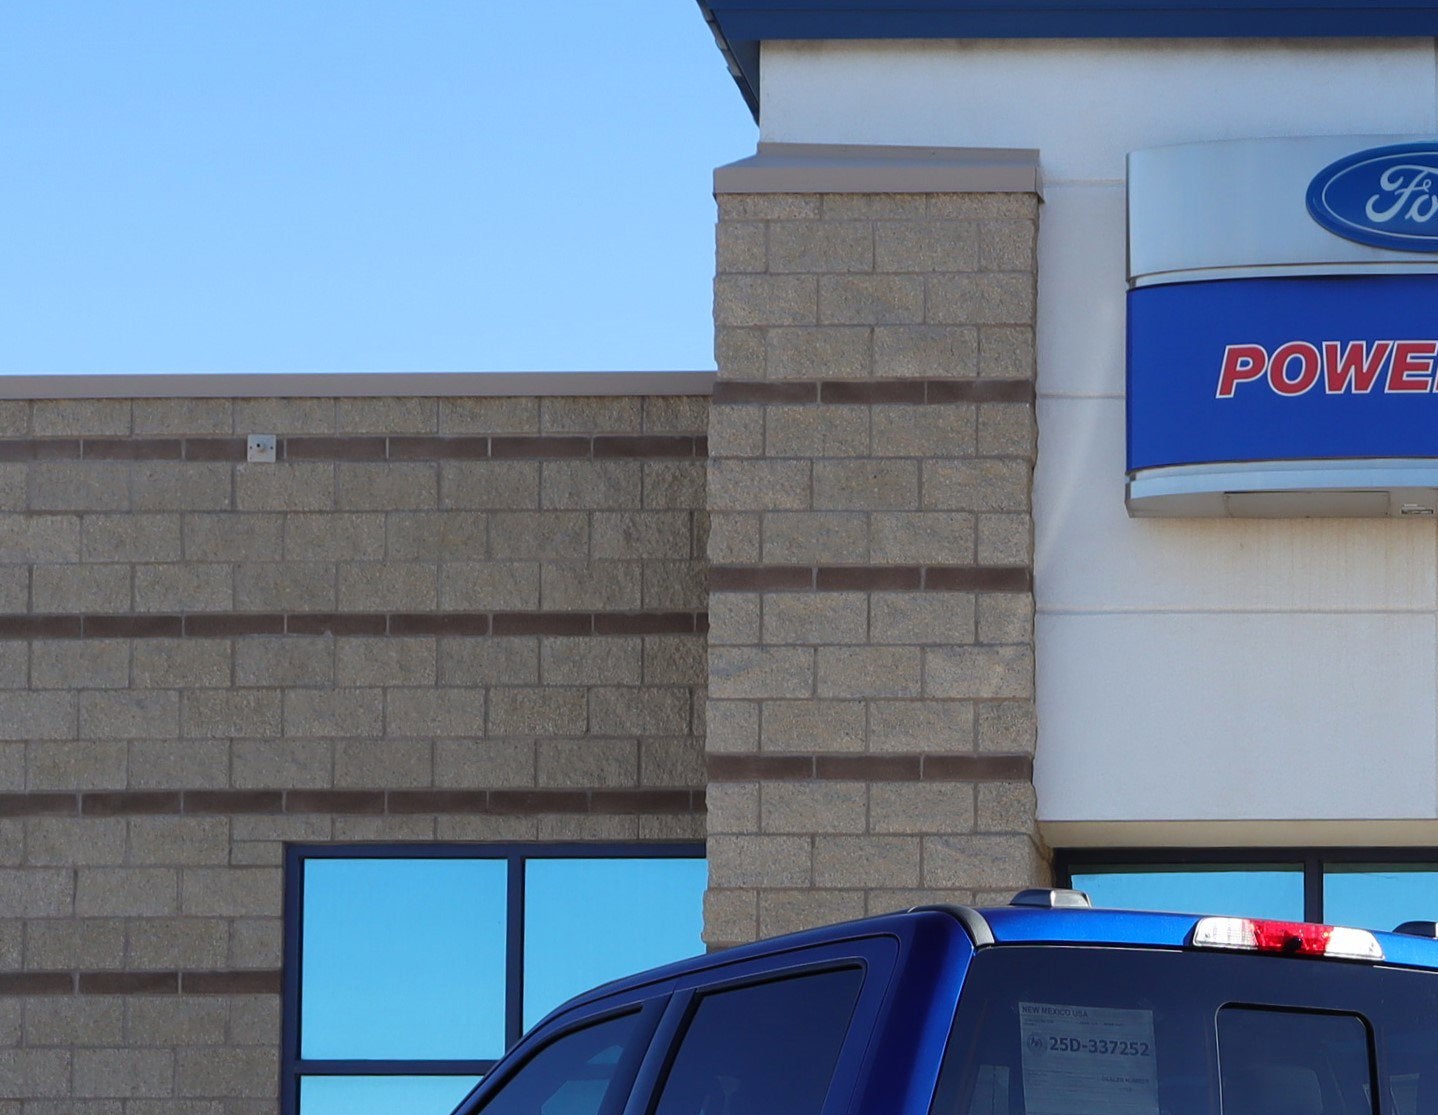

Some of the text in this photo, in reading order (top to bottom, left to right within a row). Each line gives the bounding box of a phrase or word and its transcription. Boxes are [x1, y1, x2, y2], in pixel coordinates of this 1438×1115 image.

[1022, 1005, 1088, 1018] NEW MEXICO USA
[1050, 1036, 1150, 1057] 25D-337252
